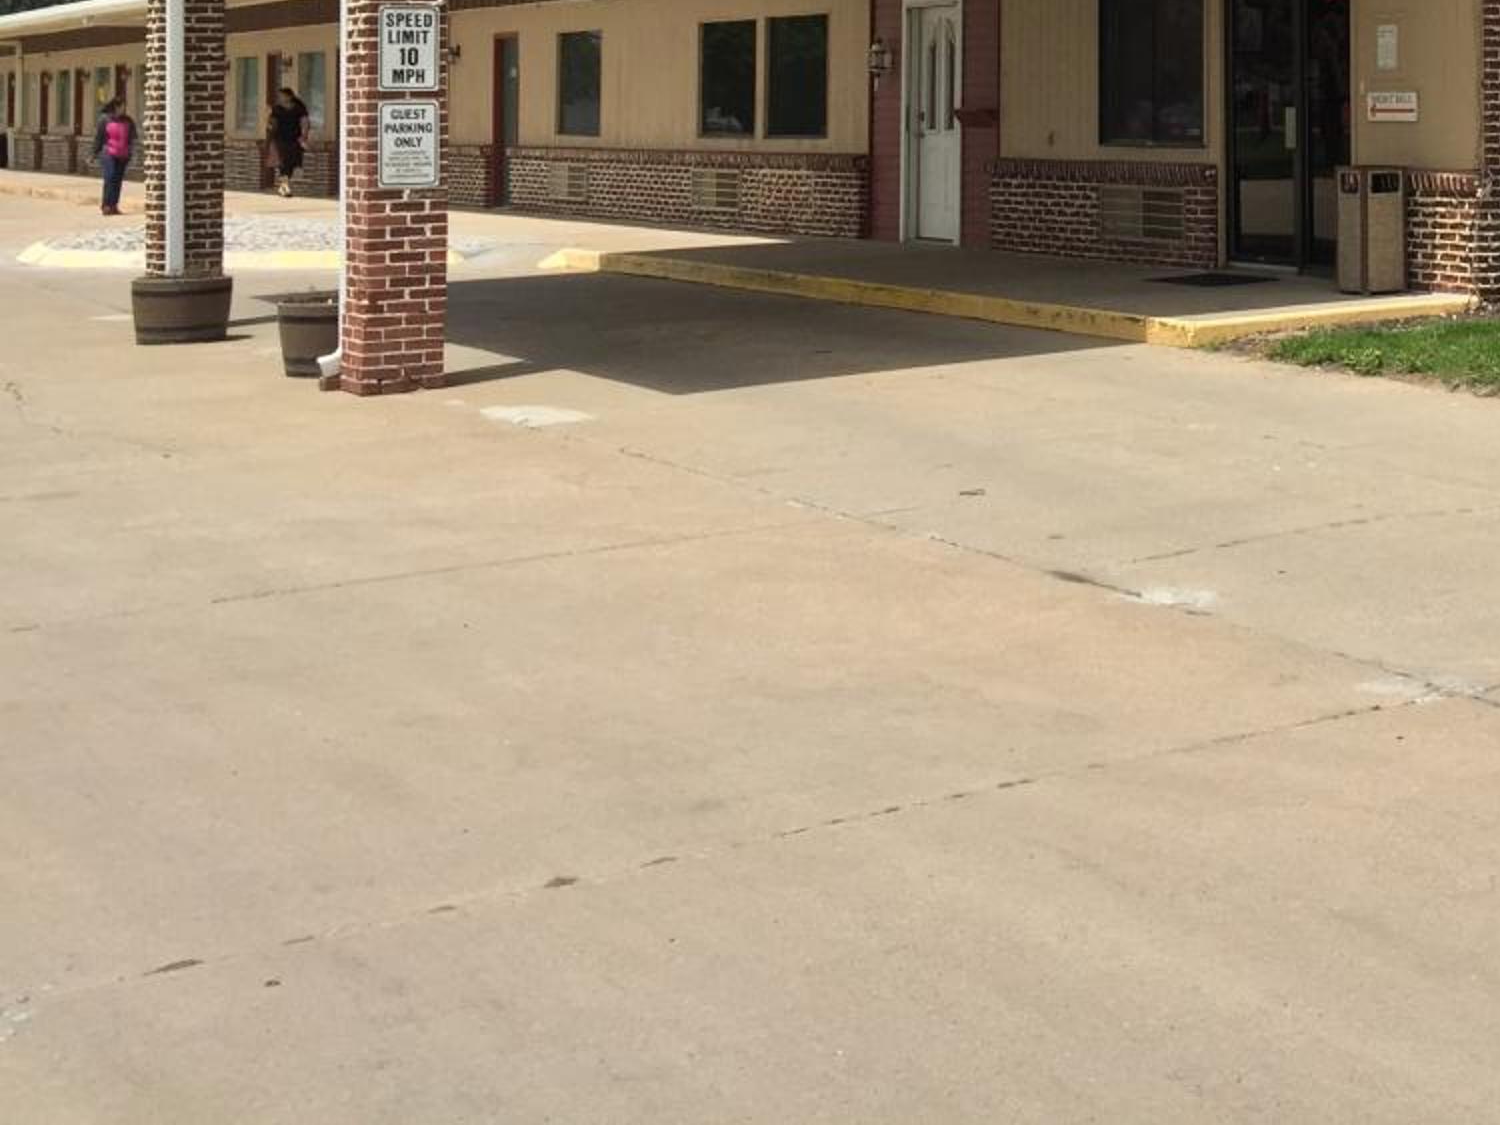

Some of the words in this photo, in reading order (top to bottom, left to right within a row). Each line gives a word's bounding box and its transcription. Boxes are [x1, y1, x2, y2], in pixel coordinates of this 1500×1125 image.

[385, 12, 433, 28] SPEED
[387, 29, 430, 44] LIMIT
[399, 47, 419, 66] 10
[392, 68, 425, 84] MPH
[390, 108, 427, 120] GUEST
[384, 122, 433, 134] PARKING
[394, 136, 423, 148] ONLY
